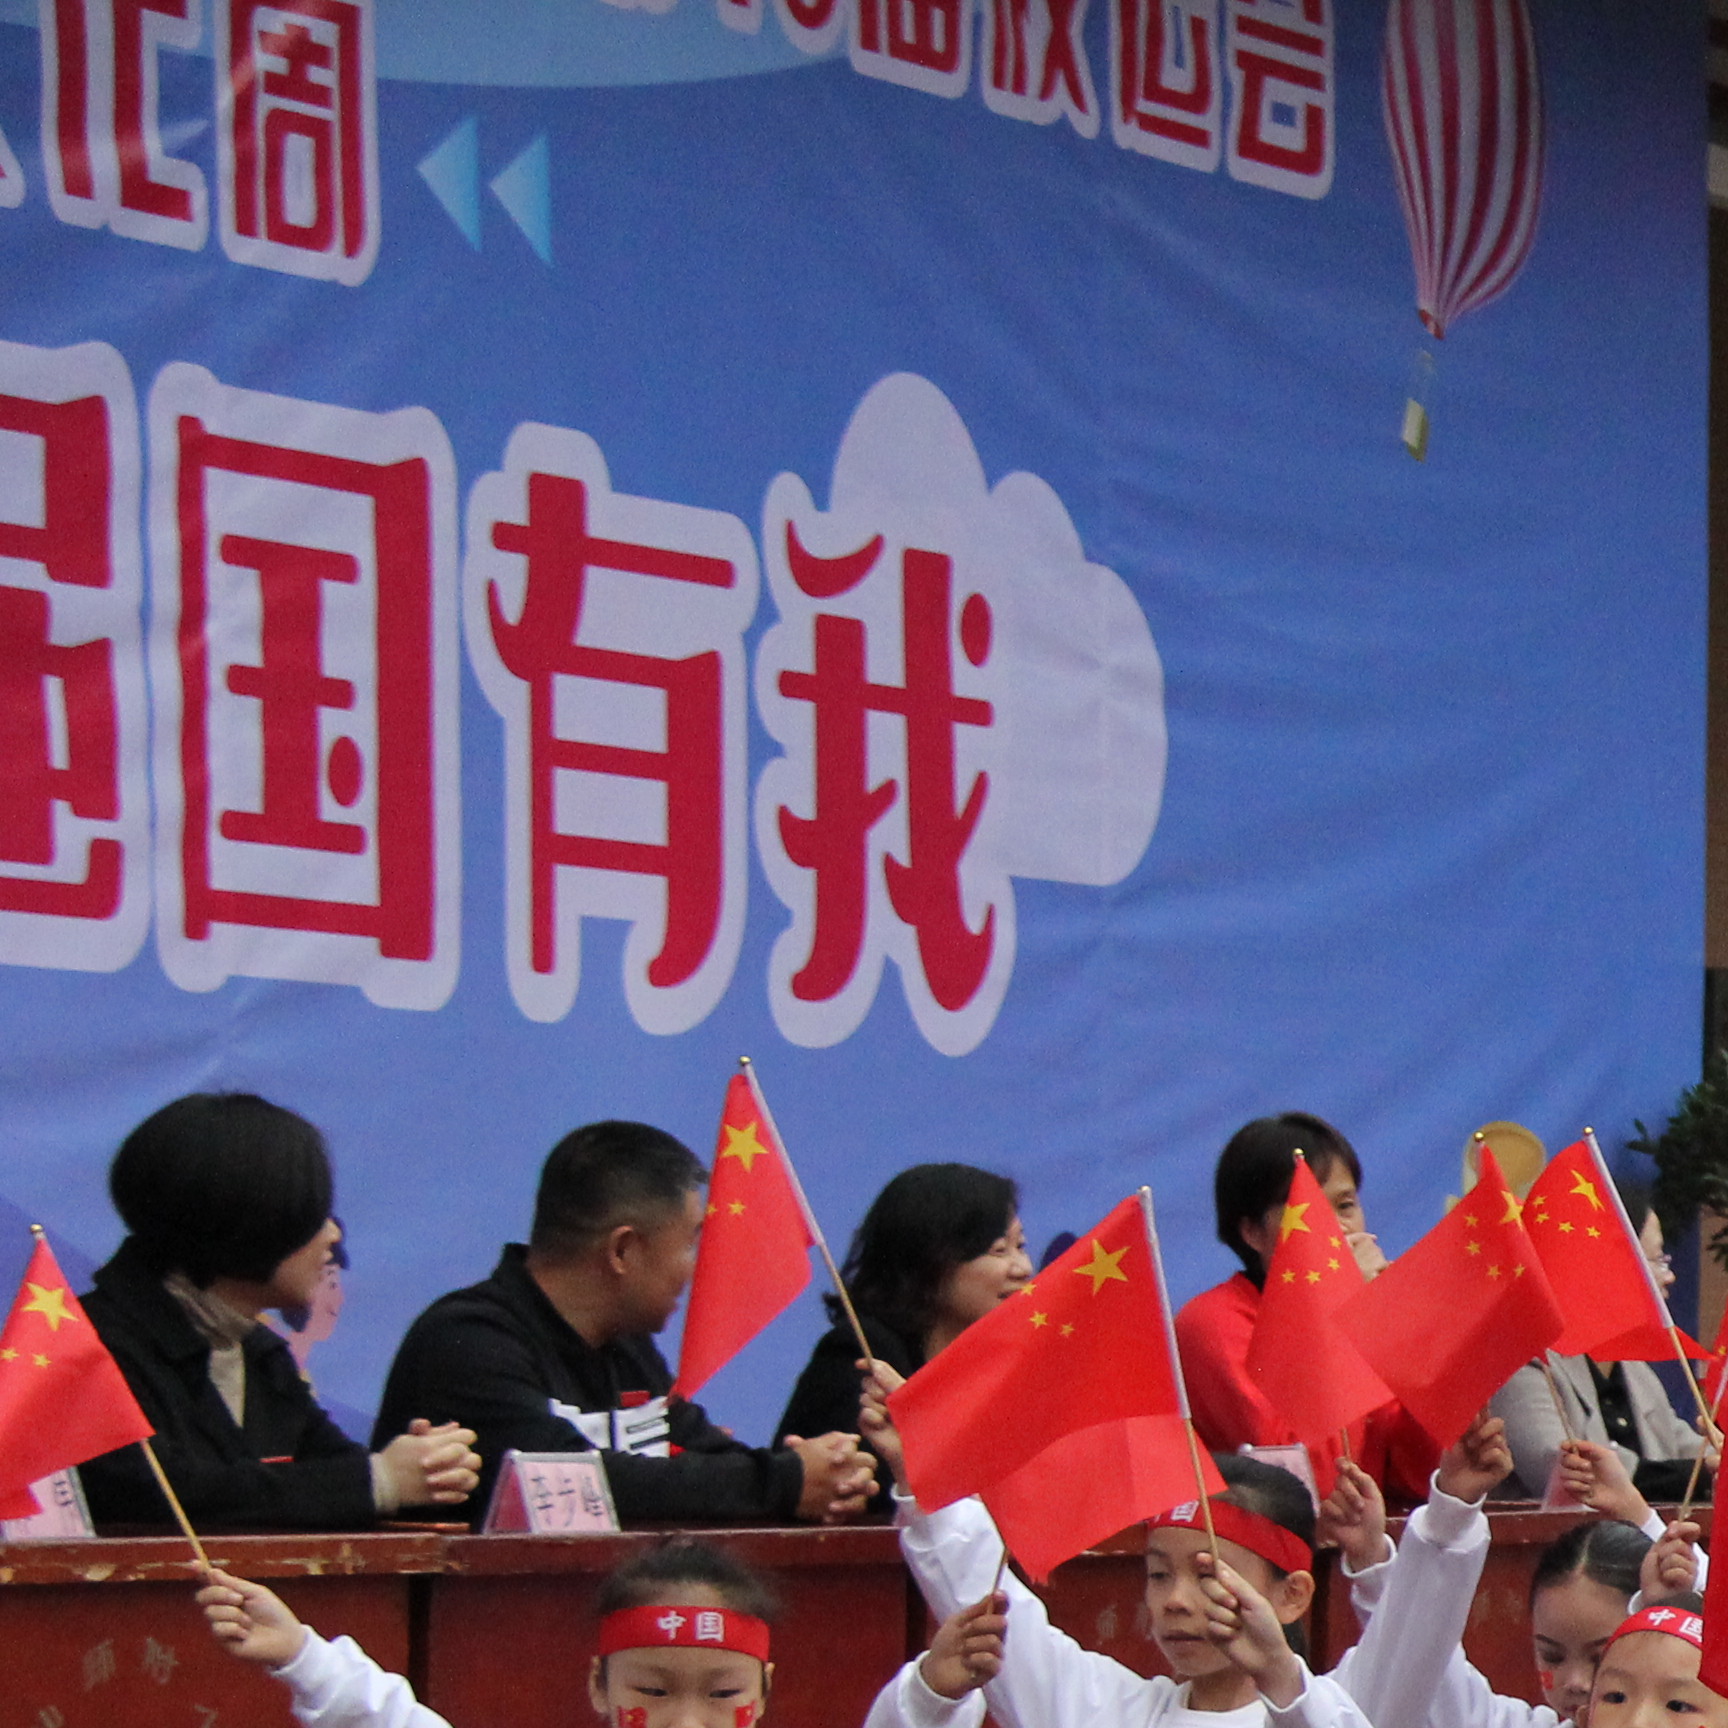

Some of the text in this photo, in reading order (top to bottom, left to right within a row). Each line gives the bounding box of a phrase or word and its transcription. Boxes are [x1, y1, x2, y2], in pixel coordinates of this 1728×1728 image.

[0, 0, 366, 258] 化周
[657, 1610, 725, 1643] 中国
[1648, 1607, 1702, 1643] 中国
